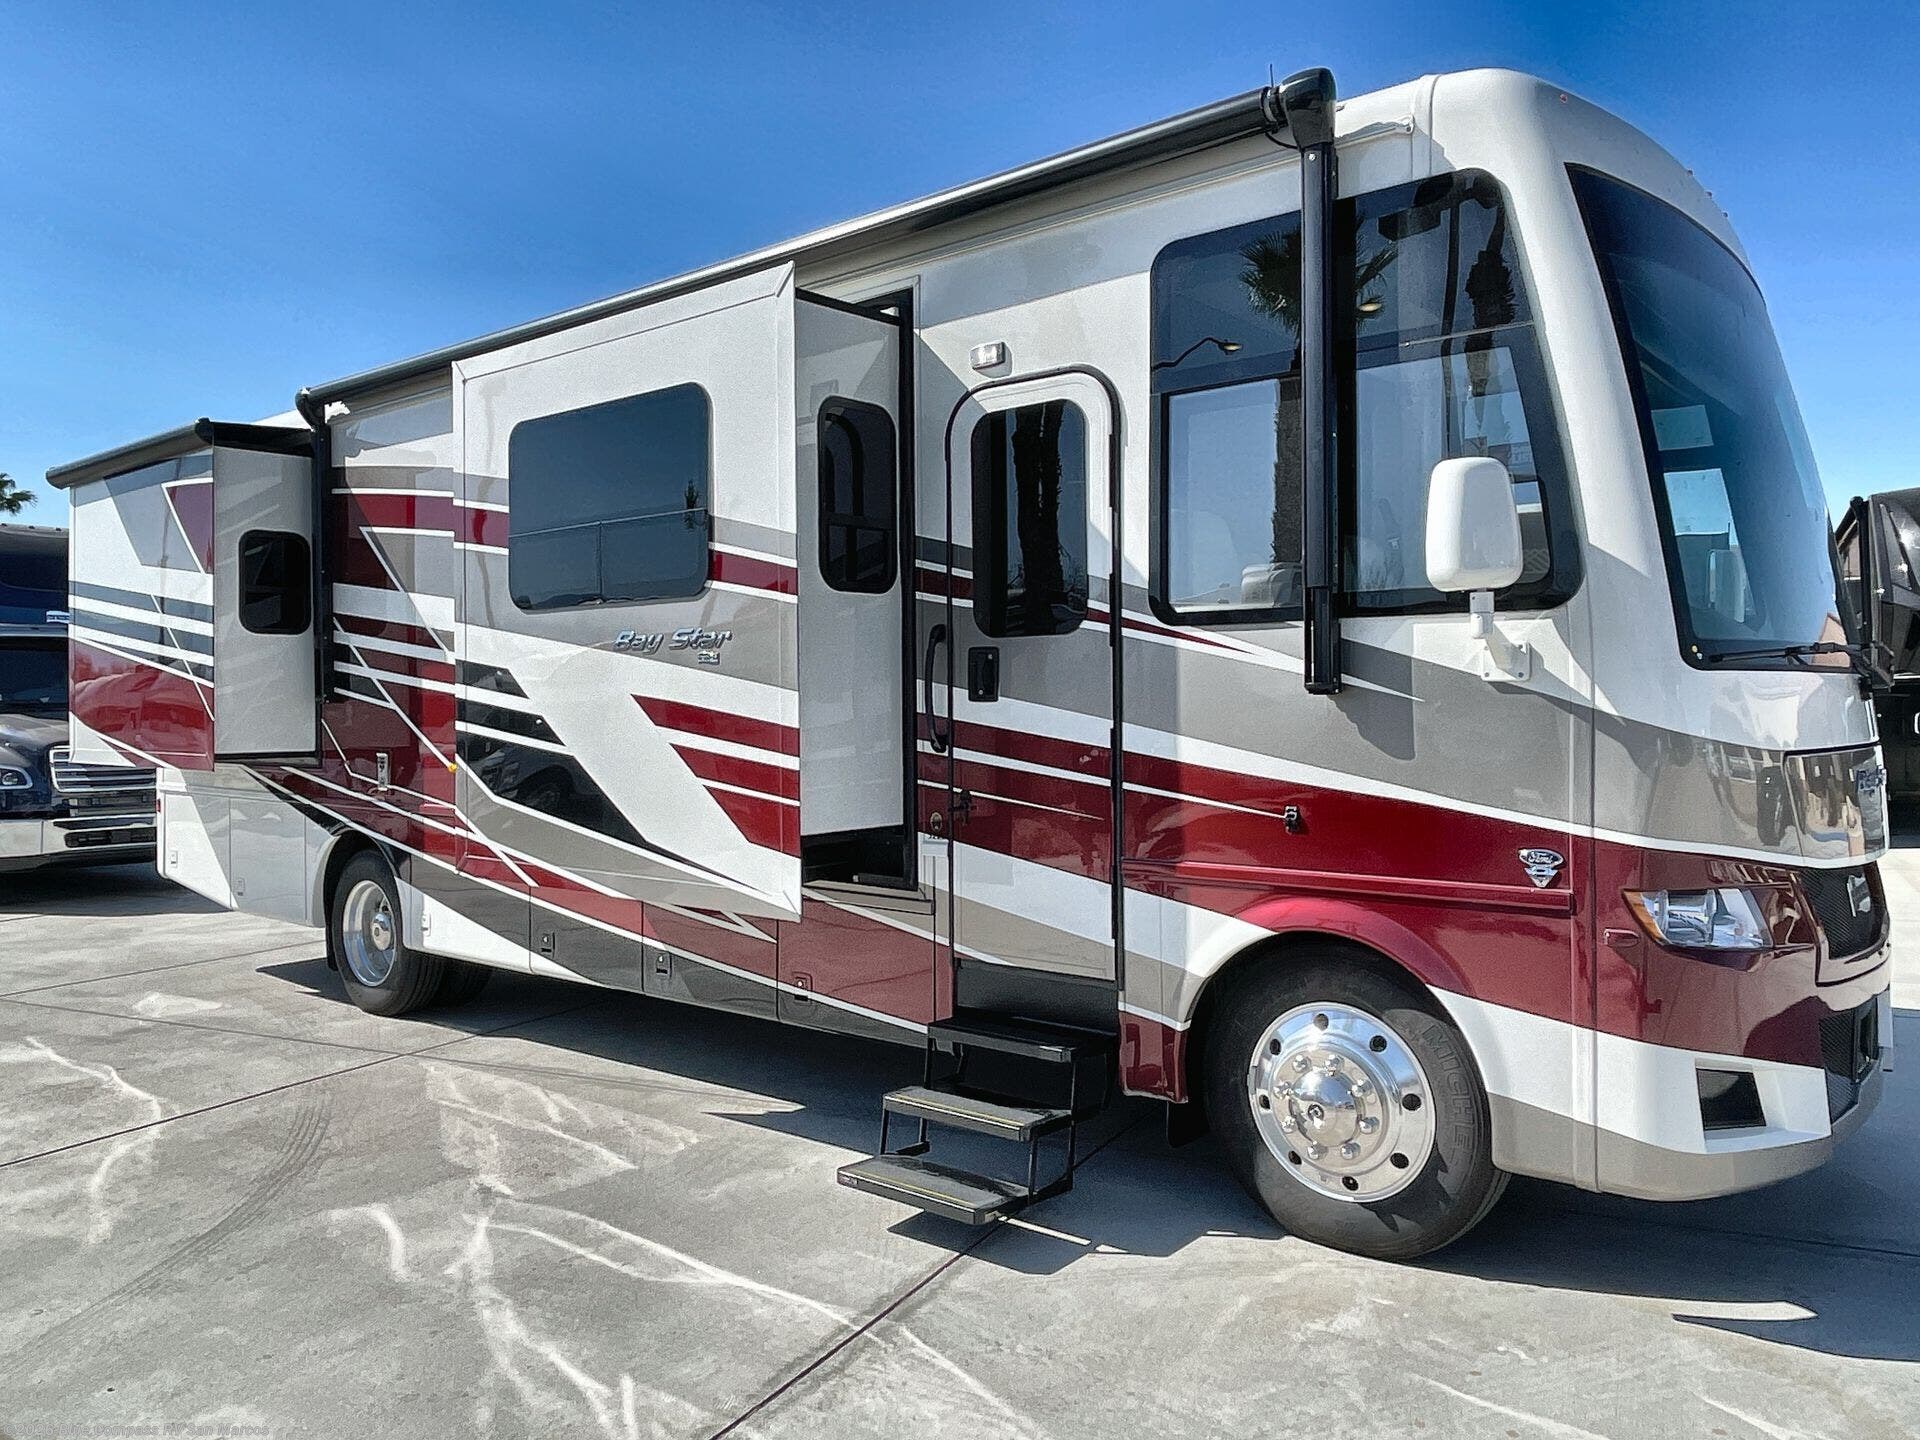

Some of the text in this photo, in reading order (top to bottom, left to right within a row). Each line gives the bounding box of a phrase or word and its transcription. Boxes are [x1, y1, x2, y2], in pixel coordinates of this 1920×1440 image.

[613, 627, 732, 654] Bay Star
[1422, 1024, 1475, 1172] MICHE
